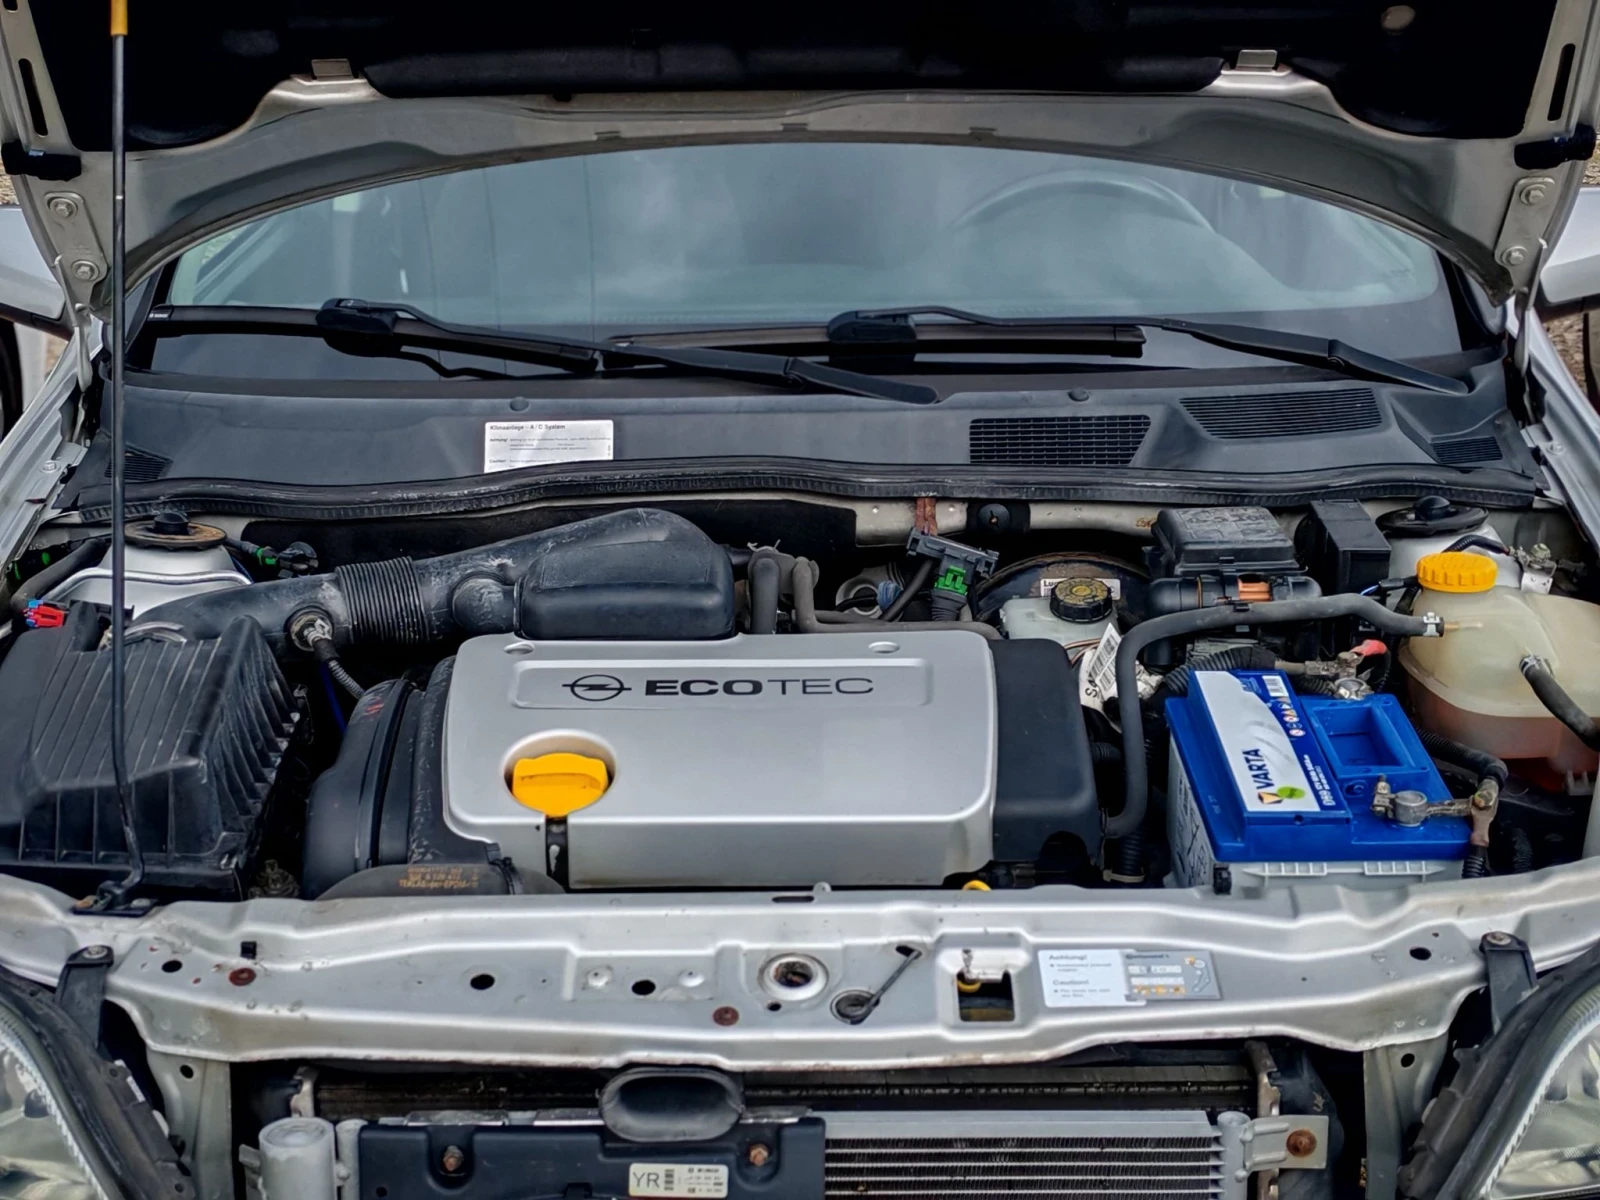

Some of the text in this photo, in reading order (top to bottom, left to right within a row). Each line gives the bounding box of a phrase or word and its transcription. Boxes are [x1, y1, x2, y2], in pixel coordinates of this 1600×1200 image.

[644, 677, 874, 696] ECOTEC
[1242, 748, 1275, 790] VARTA
[632, 1171, 660, 1189] YR
